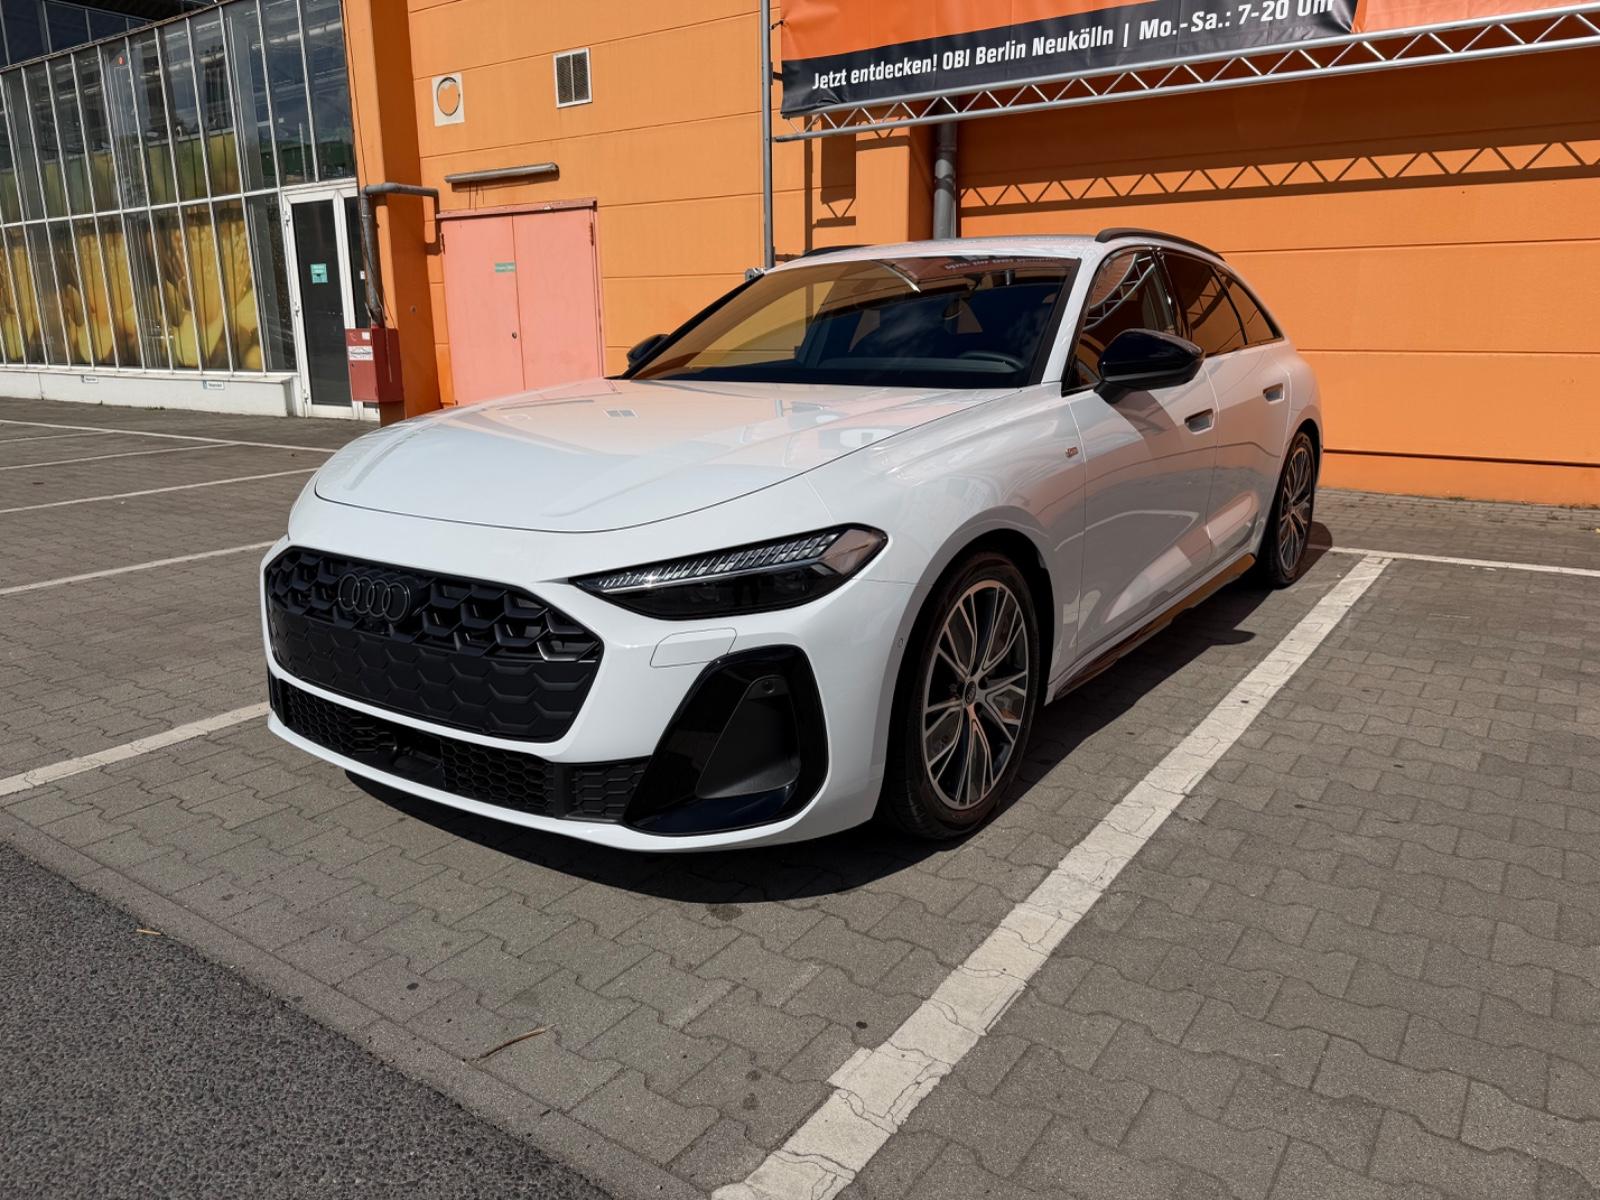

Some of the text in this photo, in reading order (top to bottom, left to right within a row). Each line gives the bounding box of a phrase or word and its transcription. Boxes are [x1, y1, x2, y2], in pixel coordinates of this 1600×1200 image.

[812, 68, 847, 89] Jetzt
[850, 53, 938, 84] entdecken!
[942, 48, 970, 70] OBI
[975, 40, 1026, 65] Berlin
[1032, 25, 1114, 56] Neukölln
[1238, 0, 1290, 25] 7-20
